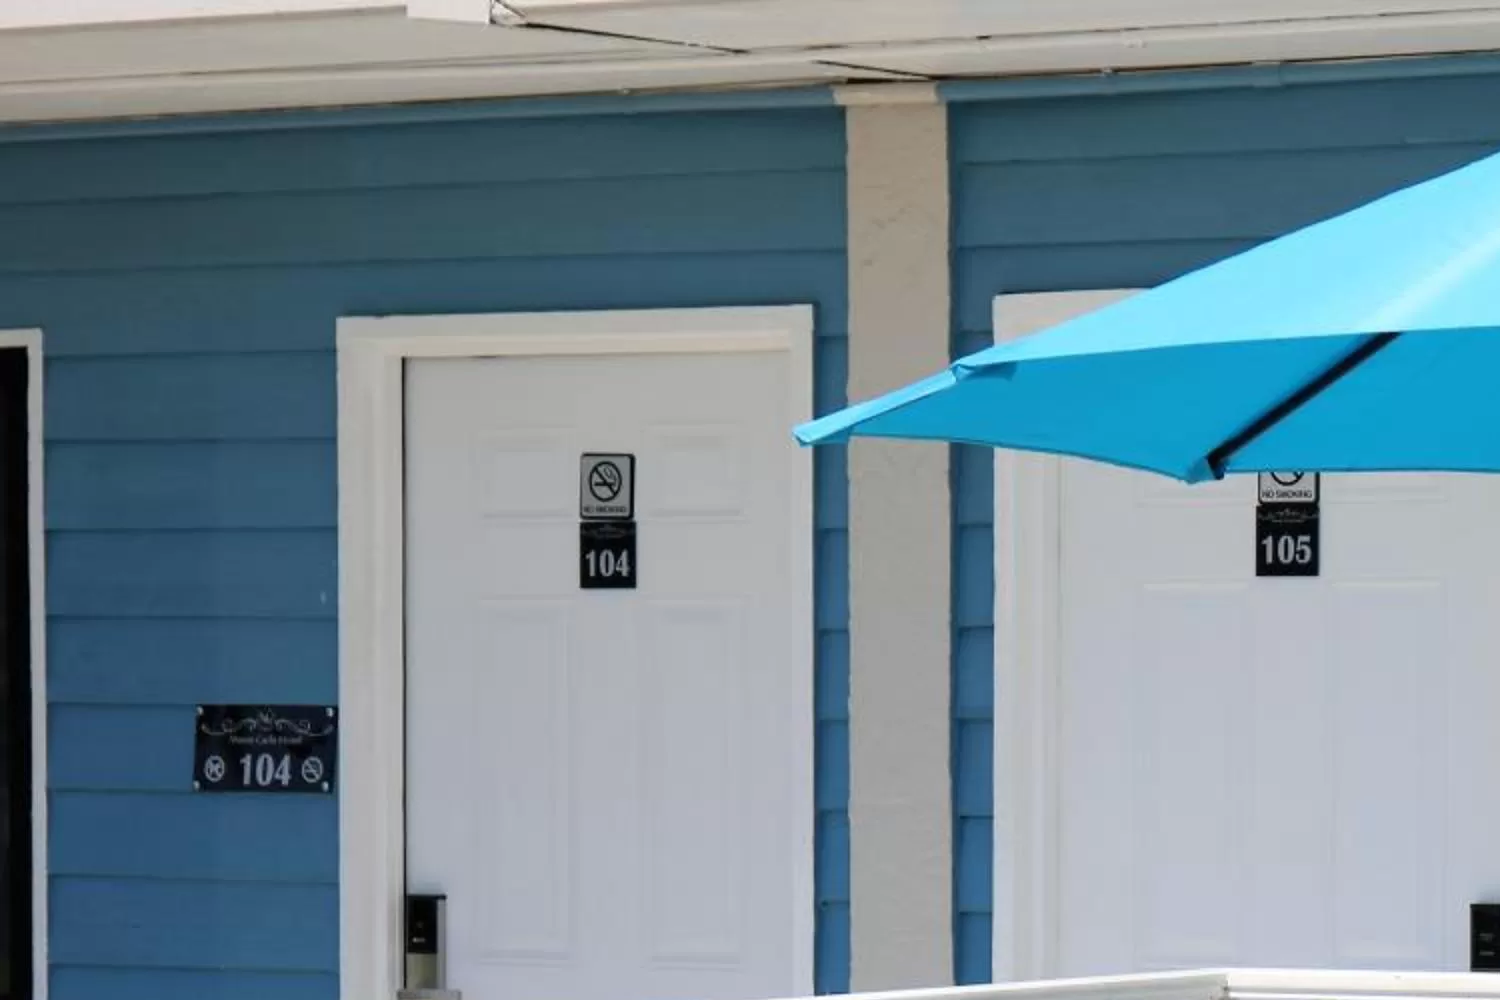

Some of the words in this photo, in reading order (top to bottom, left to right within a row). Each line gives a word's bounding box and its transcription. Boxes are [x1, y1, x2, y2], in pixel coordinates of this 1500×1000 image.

[1262, 490, 1274, 498] NO
[586, 550, 629, 577] 104
[1261, 535, 1312, 564] 105
[240, 753, 292, 786] 104
